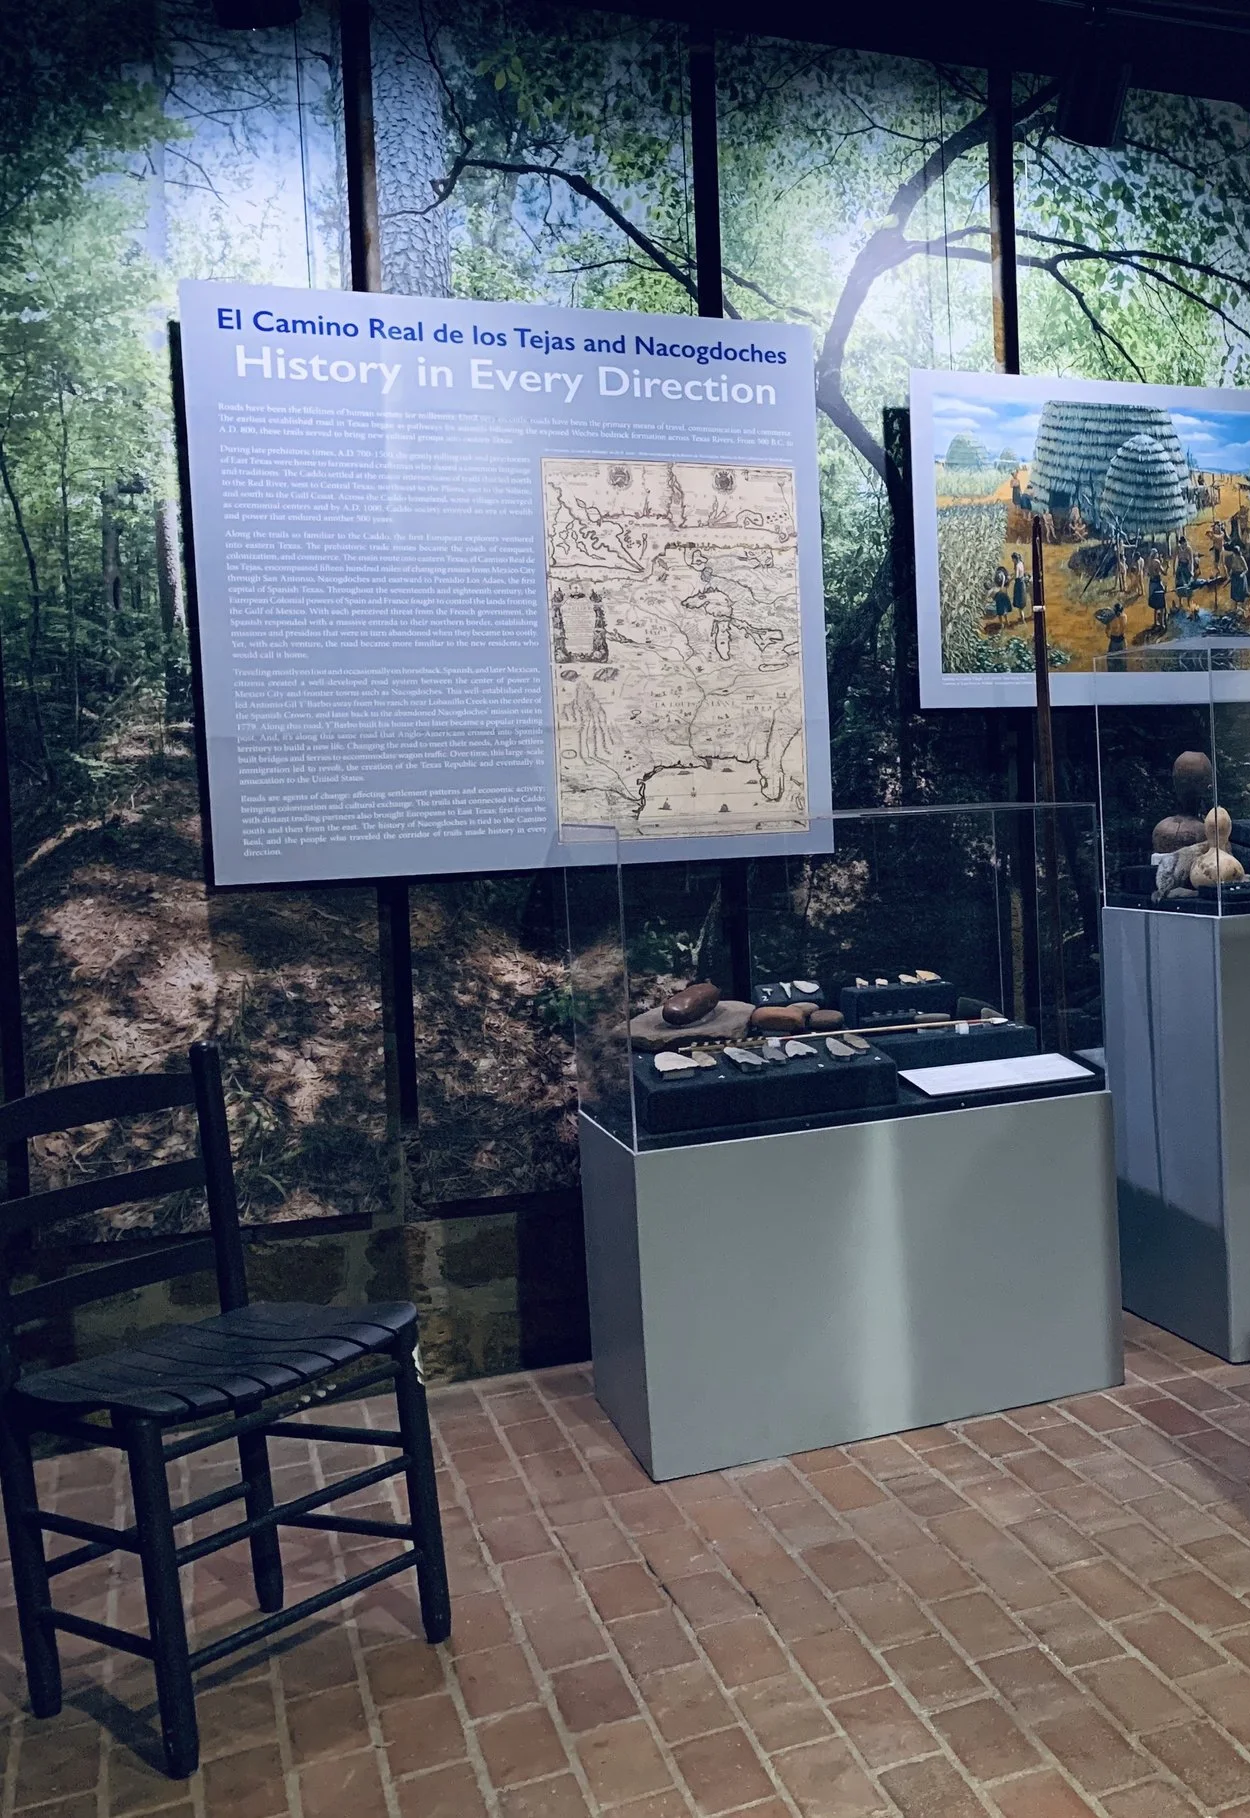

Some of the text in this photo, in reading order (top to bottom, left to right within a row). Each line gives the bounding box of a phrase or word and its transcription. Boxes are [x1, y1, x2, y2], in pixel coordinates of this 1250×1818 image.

[217, 308, 788, 366] El Camino Real de los Tejas and Nacogdoches
[235, 345, 777, 405] History in Every Direction
[267, 404, 286, 412] been
[225, 530, 251, 540] Along
[318, 575, 370, 584] Nacogdoches
[228, 585, 255, 594] capital
[267, 585, 299, 595] Spanish
[328, 586, 374, 595] Throughout
[344, 597, 366, 606] Spain
[351, 607, 388, 617] perceived
[264, 618, 307, 627] responded
[494, 618, 539, 628] establishing
[347, 741, 385, 751] Changing
[495, 758, 534, 768] eventually
[305, 824, 325, 832] from
[378, 821, 405, 831] history
[300, 835, 327, 845] people
[349, 832, 381, 841] traveled
[398, 830, 430, 838] corridor
[465, 827, 486, 836] made
[488, 826, 514, 836] history
